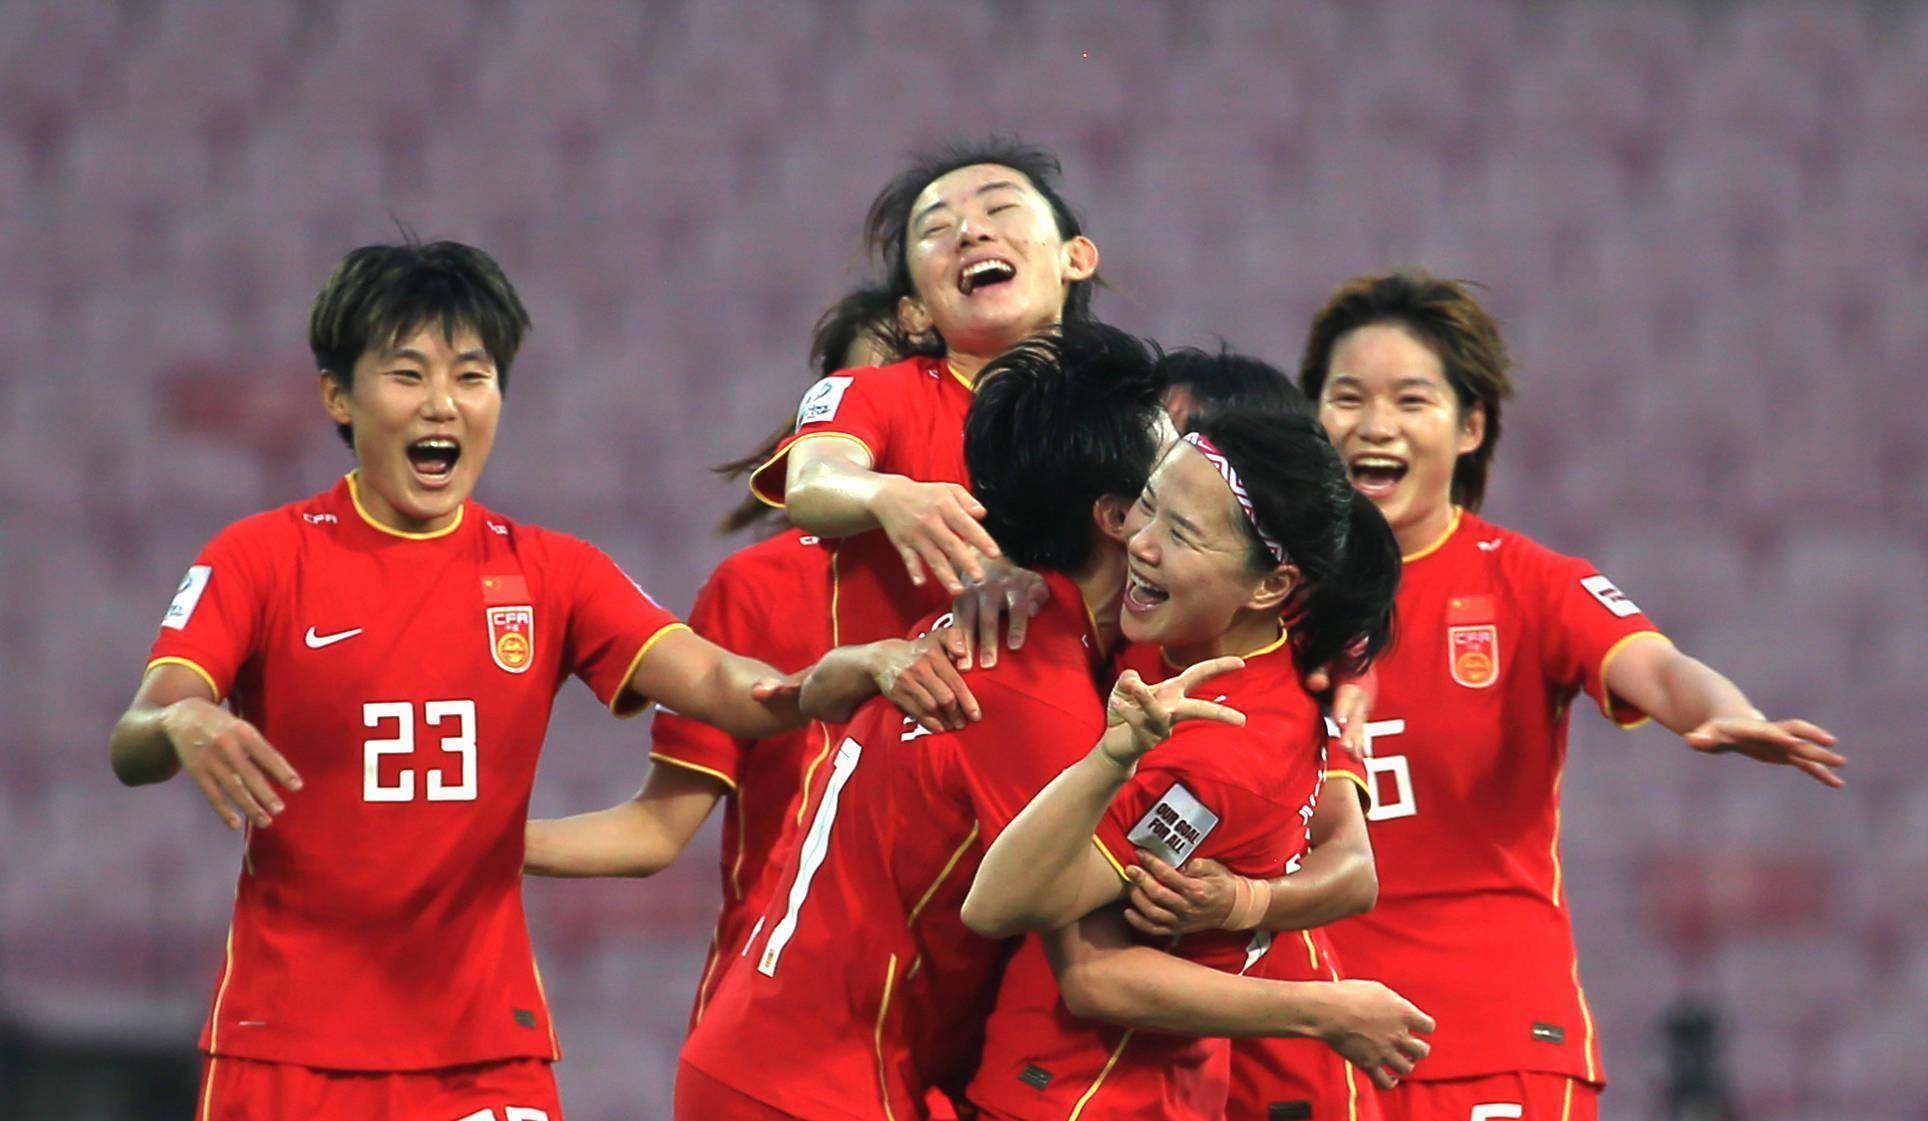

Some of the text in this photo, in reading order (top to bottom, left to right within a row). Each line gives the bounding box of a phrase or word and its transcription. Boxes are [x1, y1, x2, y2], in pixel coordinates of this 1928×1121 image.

[303, 512, 338, 525] CFA
[493, 612, 528, 625] CFA
[362, 699, 478, 802] 23
[1361, 718, 1417, 821] 6
[1147, 817, 1186, 854] FOR ALL
[1155, 802, 1201, 845] OUR GOAL
[741, 736, 863, 978] 1
